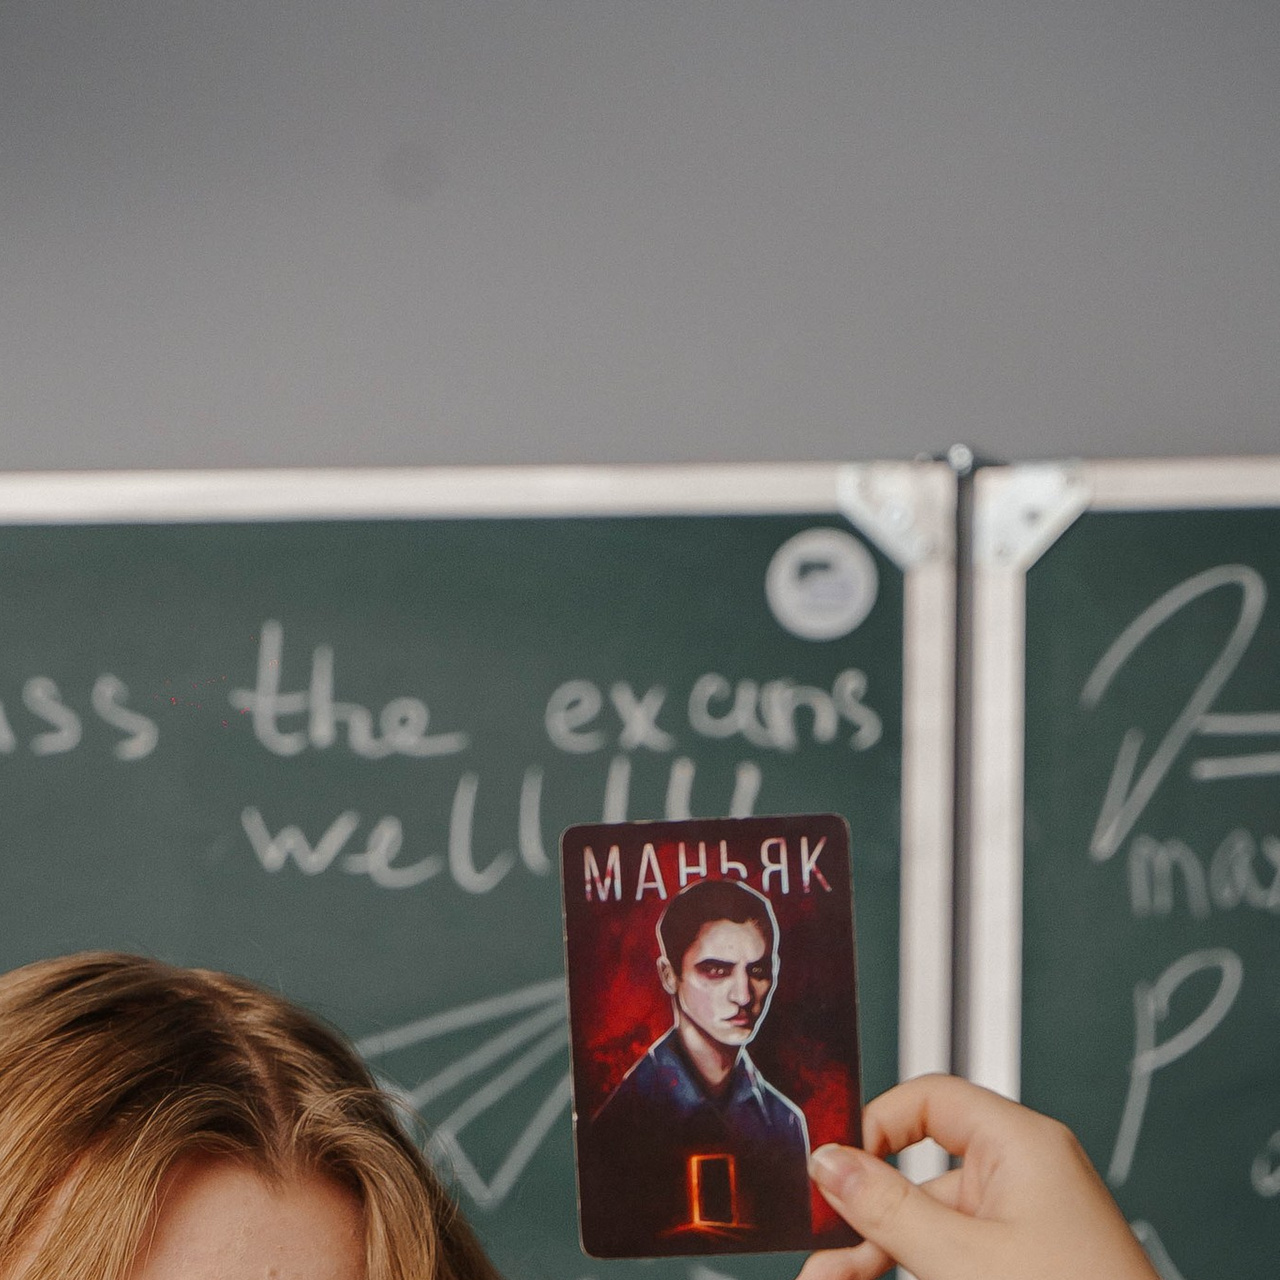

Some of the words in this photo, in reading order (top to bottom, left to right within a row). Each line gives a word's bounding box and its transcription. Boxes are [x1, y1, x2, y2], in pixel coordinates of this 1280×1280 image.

[228, 618, 470, 757] the
[545, 667, 883, 754] exams
[583, 836, 833, 901] МАНЬЯК
